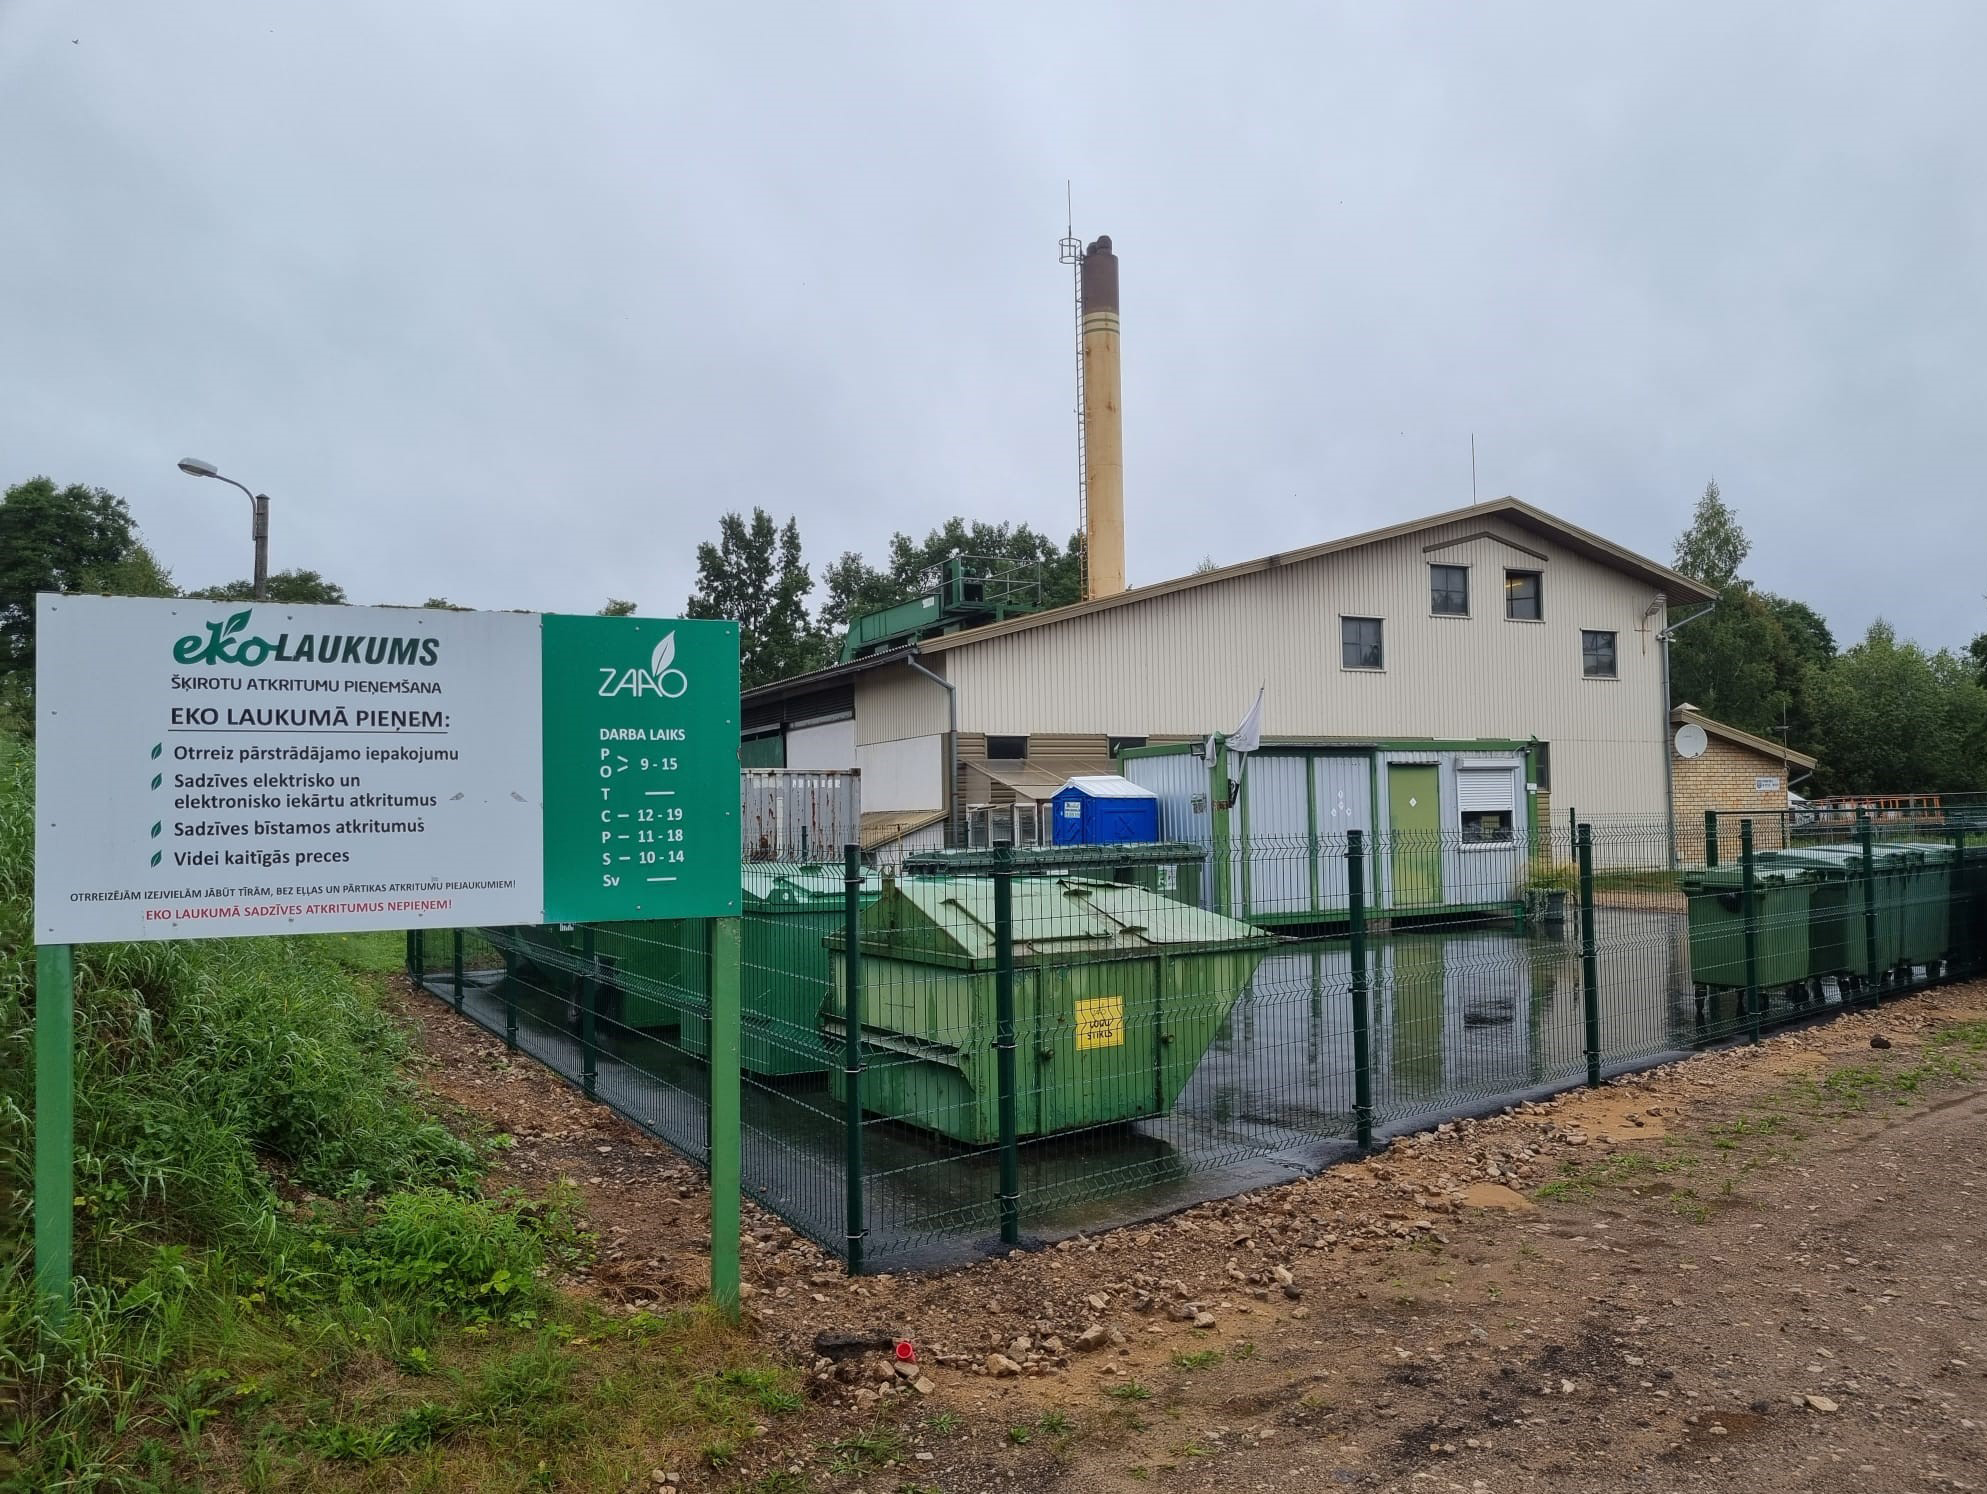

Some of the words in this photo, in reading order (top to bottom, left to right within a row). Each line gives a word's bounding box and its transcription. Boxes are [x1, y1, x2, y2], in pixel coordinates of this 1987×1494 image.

[171, 674, 242, 692] ŠĶIROTU
[247, 678, 339, 692] ATKRITUMU
[344, 679, 442, 695] PIEŅEMŠANA
[598, 668, 688, 698] ZAAO
[171, 707, 219, 725] EKO
[227, 706, 349, 726] LAUKUMĀ
[356, 710, 450, 731] PIEŅEM:
[600, 728, 646, 741] DARBA
[650, 728, 686, 741] LAIKS
[174, 746, 234, 760] Otrreiz
[239, 746, 361, 763] pārstrādājamo
[366, 746, 459, 763] iepakojumu
[601, 748, 610, 760] P
[600, 765, 612, 779] O
[640, 758, 649, 771] 9
[662, 758, 678, 770] 15
[174, 773, 248, 788] Sadzīves
[253, 773, 335, 788] elektrisko
[340, 776, 361, 787] un
[174, 794, 281, 809] elektronisko
[286, 794, 345, 808] iekārtu
[350, 793, 437, 807] atkritumus
[601, 788, 610, 800] T
[601, 811, 611, 823] C
[638, 809, 654, 822] 12
[667, 809, 683, 821] 19
[174, 821, 249, 836] Sadzīves
[254, 820, 331, 835] bīstamos
[336, 819, 425, 834] atkritumus
[602, 832, 611, 844] P
[638, 831, 654, 843] 11
[667, 830, 683, 842] 18
[174, 851, 219, 866] Videi
[225, 850, 290, 868] kaitīgās
[295, 851, 350, 867] preces
[602, 853, 611, 865] S
[639, 852, 655, 864] 10
[668, 851, 685, 864] 14
[603, 875, 620, 887] Sv
[70, 890, 141, 902] OTRREIZĒJĀM
[144, 888, 202, 900] IZEJVIELĀM
[204, 887, 236, 898] JĀBŪT
[238, 886, 274, 897] TĪRĀM,
[276, 886, 294, 896] BEZ
[296, 886, 323, 896] EĻĻAS
[326, 886, 340, 894] UN
[343, 883, 387, 893] PĀRTIKAS
[389, 882, 443, 892] ATKRITUMU
[446, 880, 516, 890] PIEJAUKUMIEM!
[146, 910, 172, 920] EKO
[175, 906, 241, 919] LAUKUMĀ
[244, 904, 303, 917] SADZĪVES
[306, 901, 384, 914] ATKRITUMUS
[387, 899, 452, 912] NEPIEŅEM!
